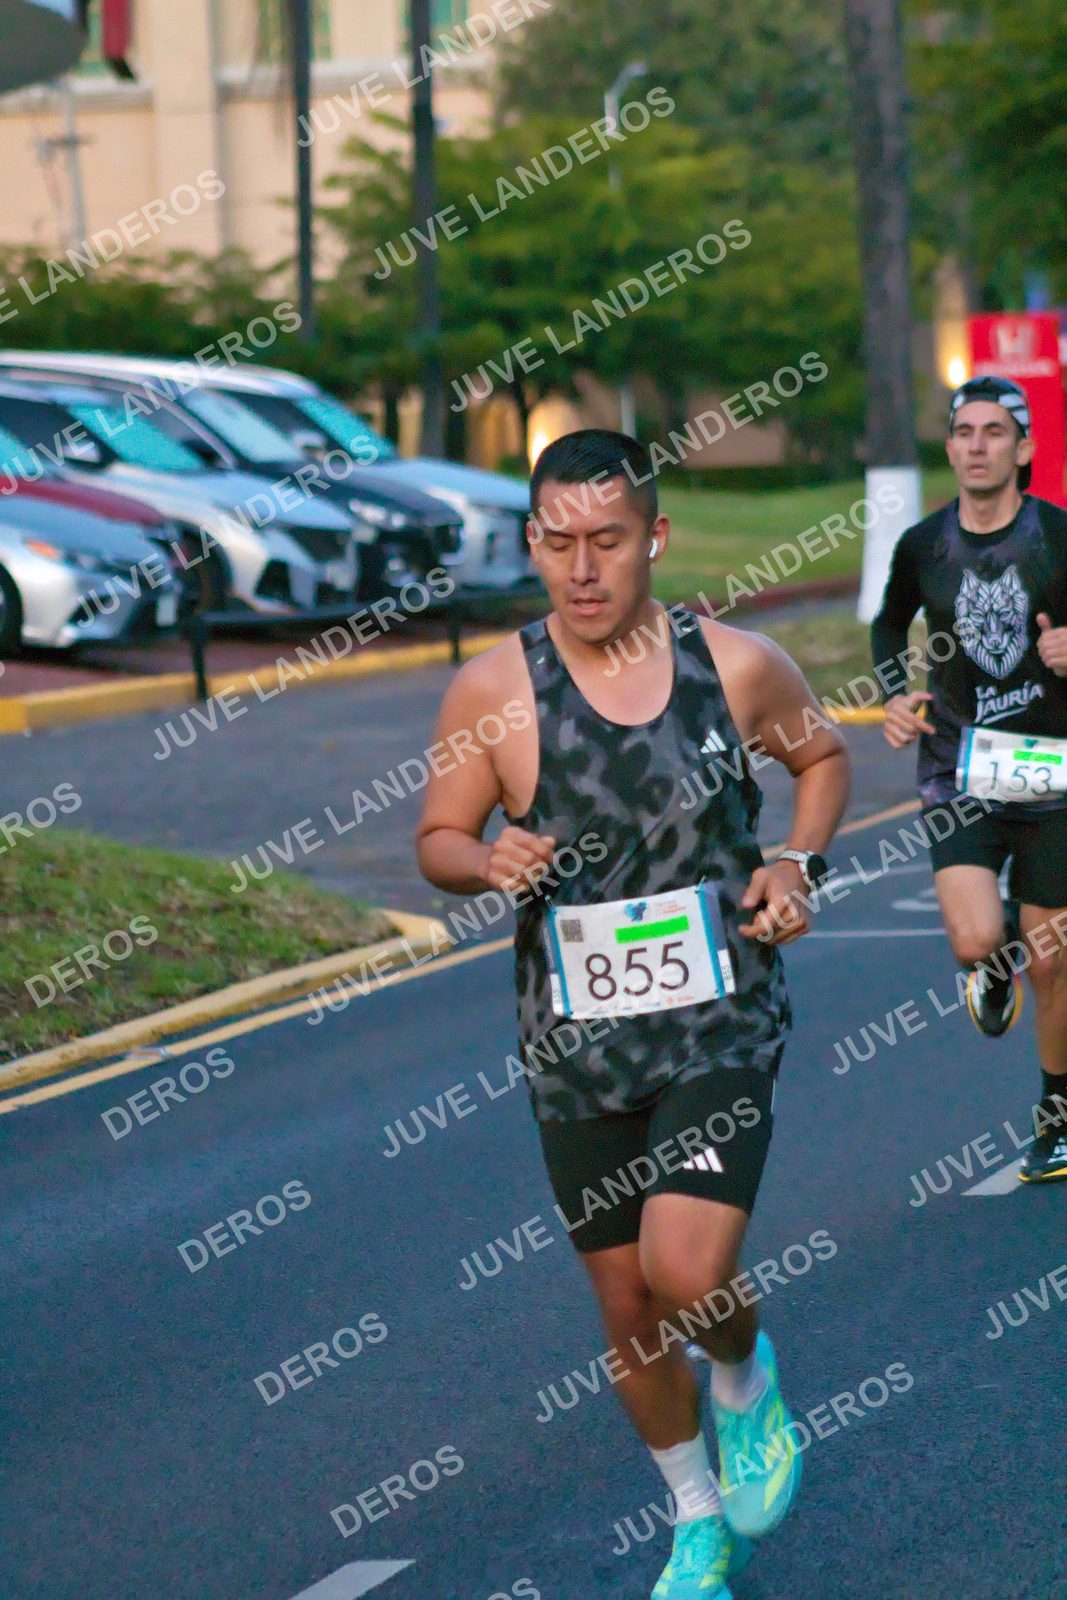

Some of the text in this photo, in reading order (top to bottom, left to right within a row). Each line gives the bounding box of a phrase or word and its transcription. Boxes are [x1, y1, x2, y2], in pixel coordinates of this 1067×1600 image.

[975, 685, 997, 700] LA
[989, 761, 1053, 796] 153
[584, 941, 690, 1001] 855
